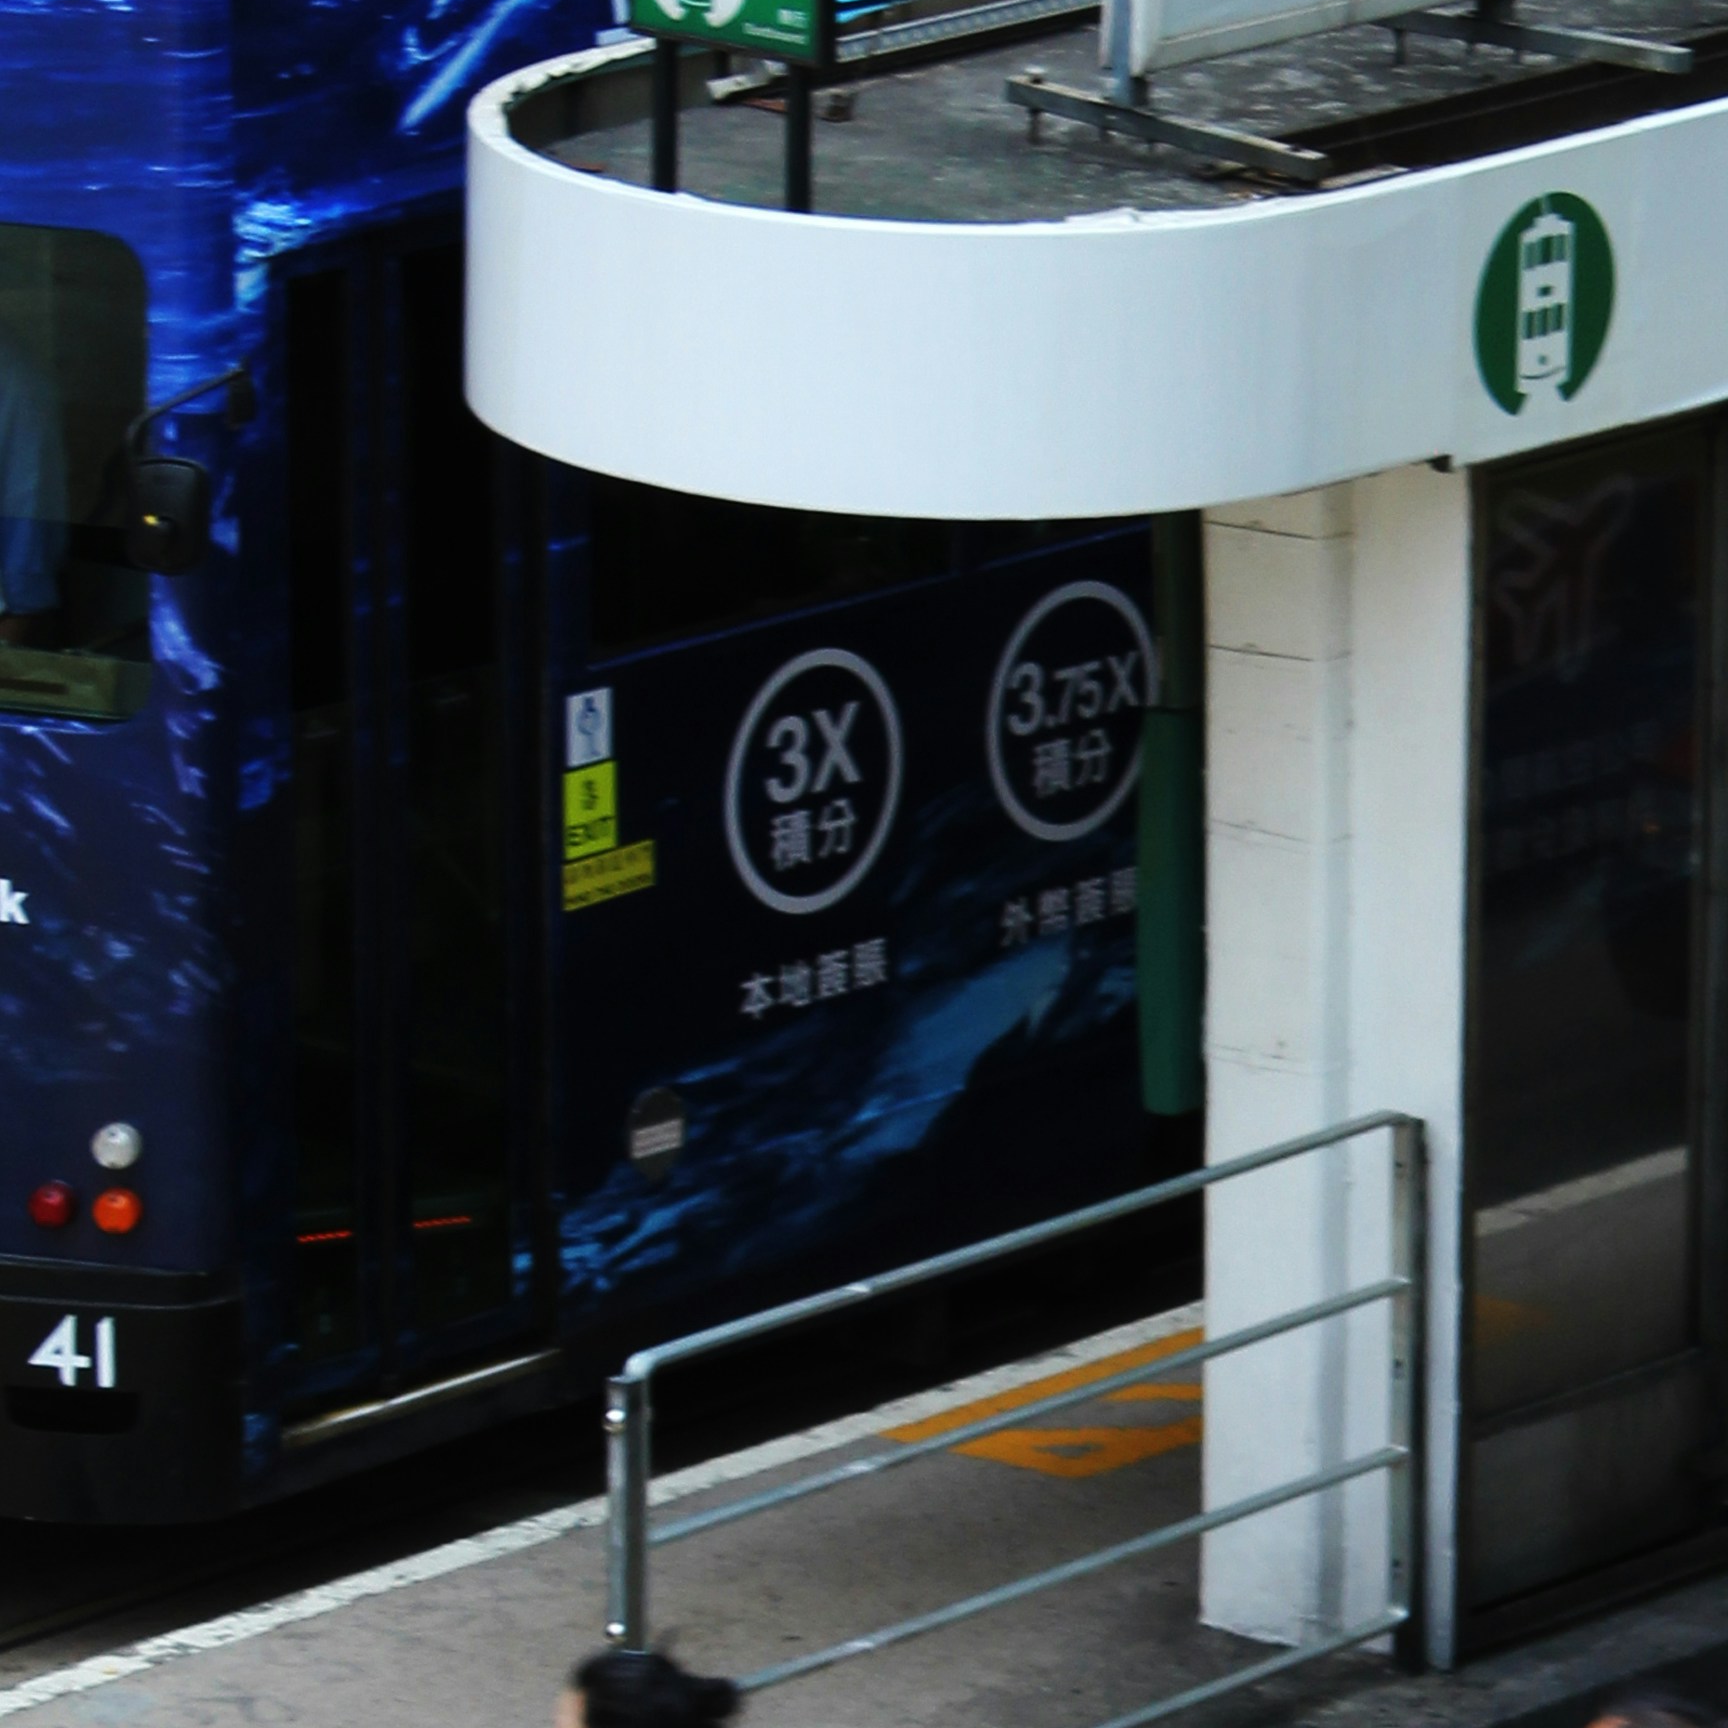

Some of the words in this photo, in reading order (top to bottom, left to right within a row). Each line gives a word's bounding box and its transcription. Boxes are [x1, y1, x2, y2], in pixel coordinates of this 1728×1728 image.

[1005, 650, 1145, 739] 3.75X
[763, 700, 864, 805] 3X
[1031, 728, 1114, 800] 積分
[769, 798, 859, 873] 積分
[27, 1314, 118, 1389] 41
